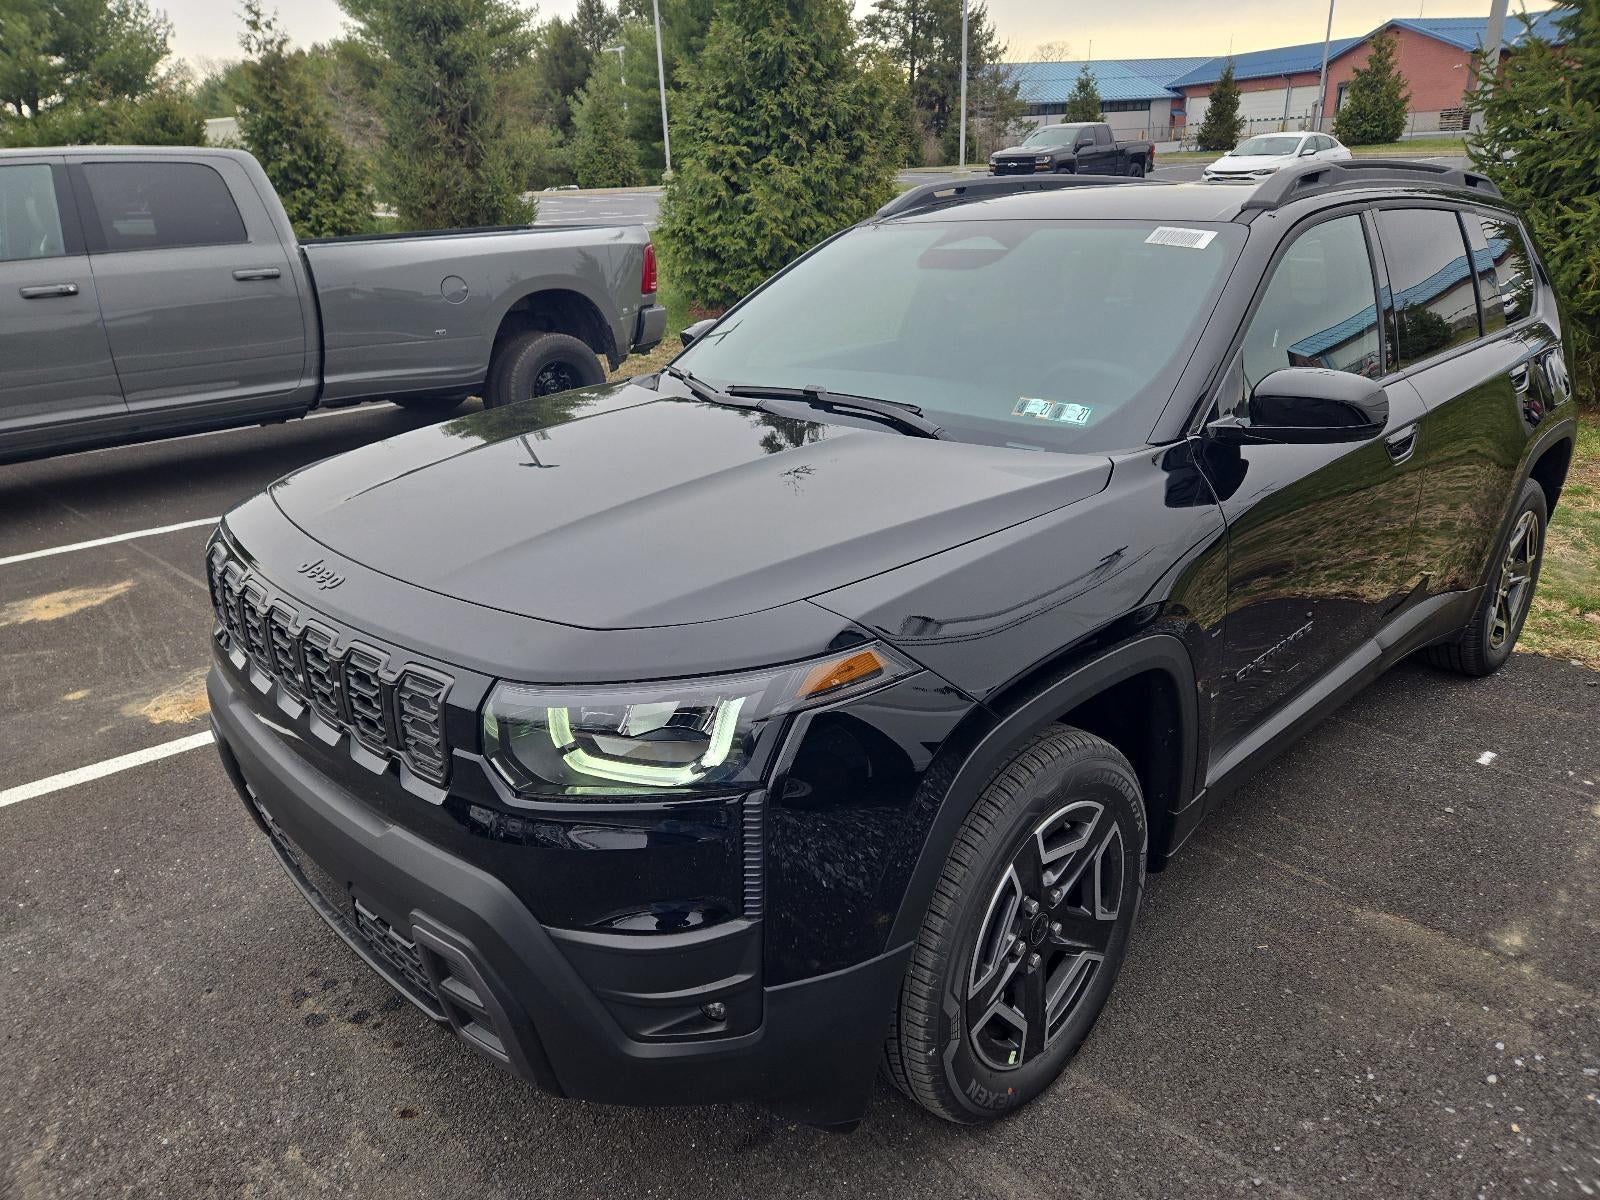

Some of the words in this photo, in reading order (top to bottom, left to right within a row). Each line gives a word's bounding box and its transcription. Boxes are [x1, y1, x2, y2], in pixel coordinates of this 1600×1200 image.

[1039, 402, 1053, 416] 27
[1077, 407, 1090, 421] 27
[296, 558, 346, 591] Jeep
